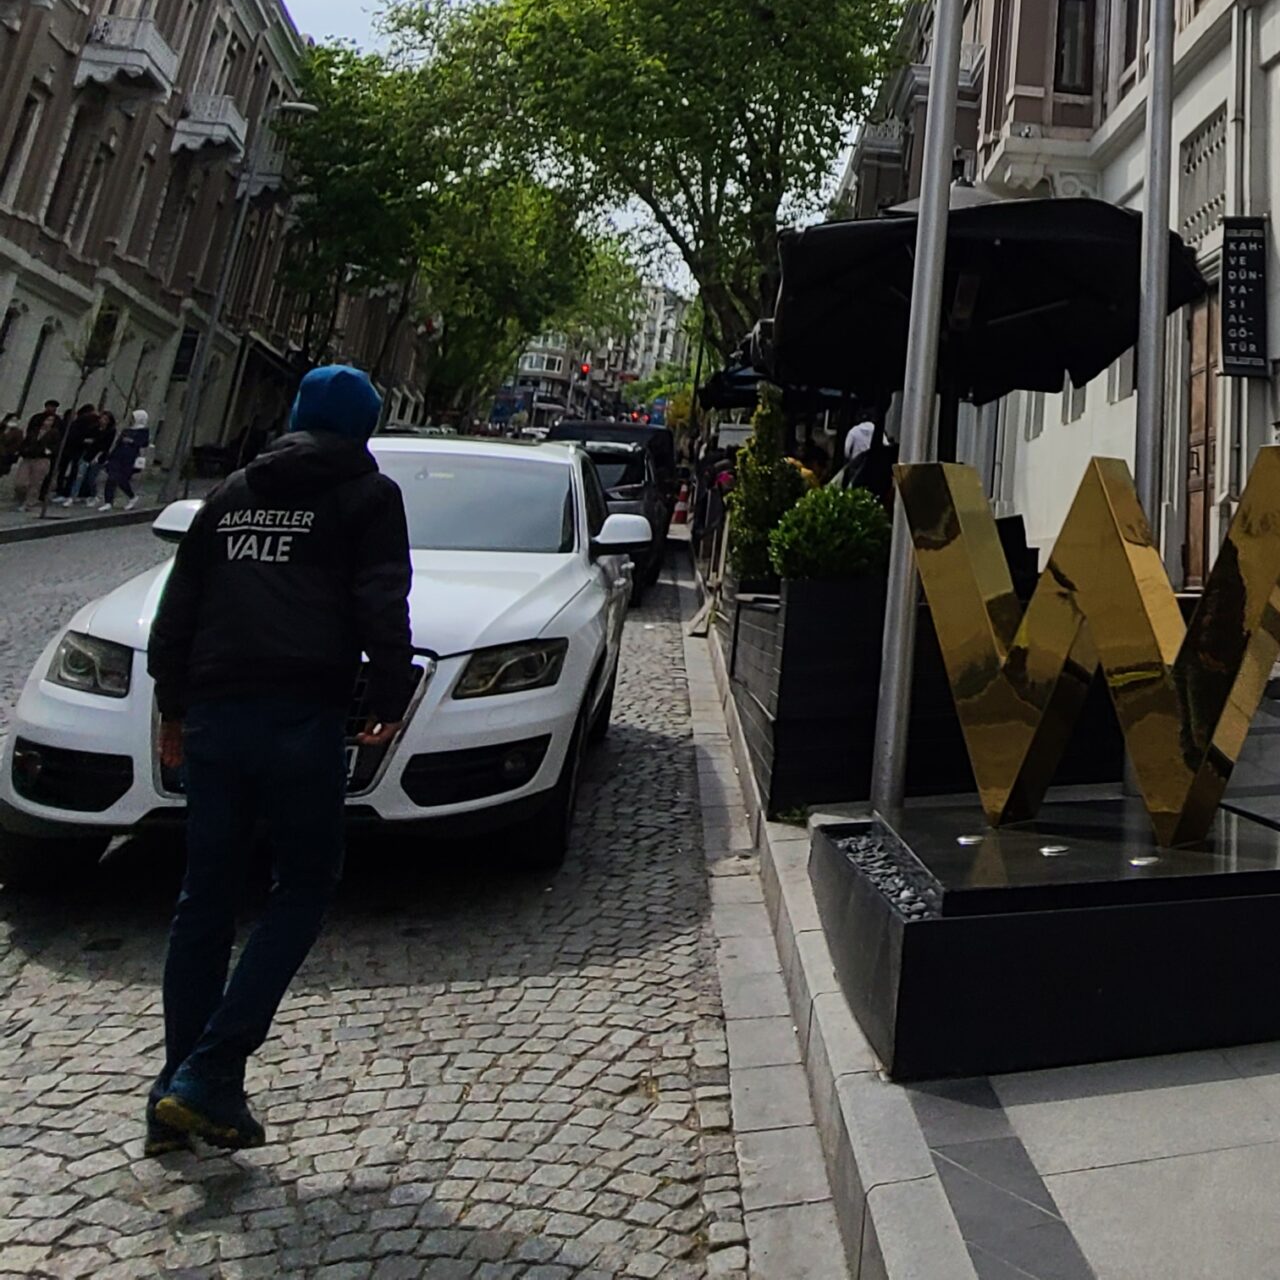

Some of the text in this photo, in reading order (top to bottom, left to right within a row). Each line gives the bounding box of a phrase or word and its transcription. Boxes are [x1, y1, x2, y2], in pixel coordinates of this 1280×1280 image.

[1228, 241, 1263, 251] KAH-
[1228, 255, 1247, 265] VE
[1228, 268, 1263, 280] DÜN-
[1228, 284, 1254, 294] YA-
[1228, 314, 1254, 324] AL-
[1228, 327, 1254, 338] GÖ-
[1228, 341, 1257, 353] TÜR
[217, 508, 315, 527] AKARETLER
[227, 534, 293, 562] VALE
